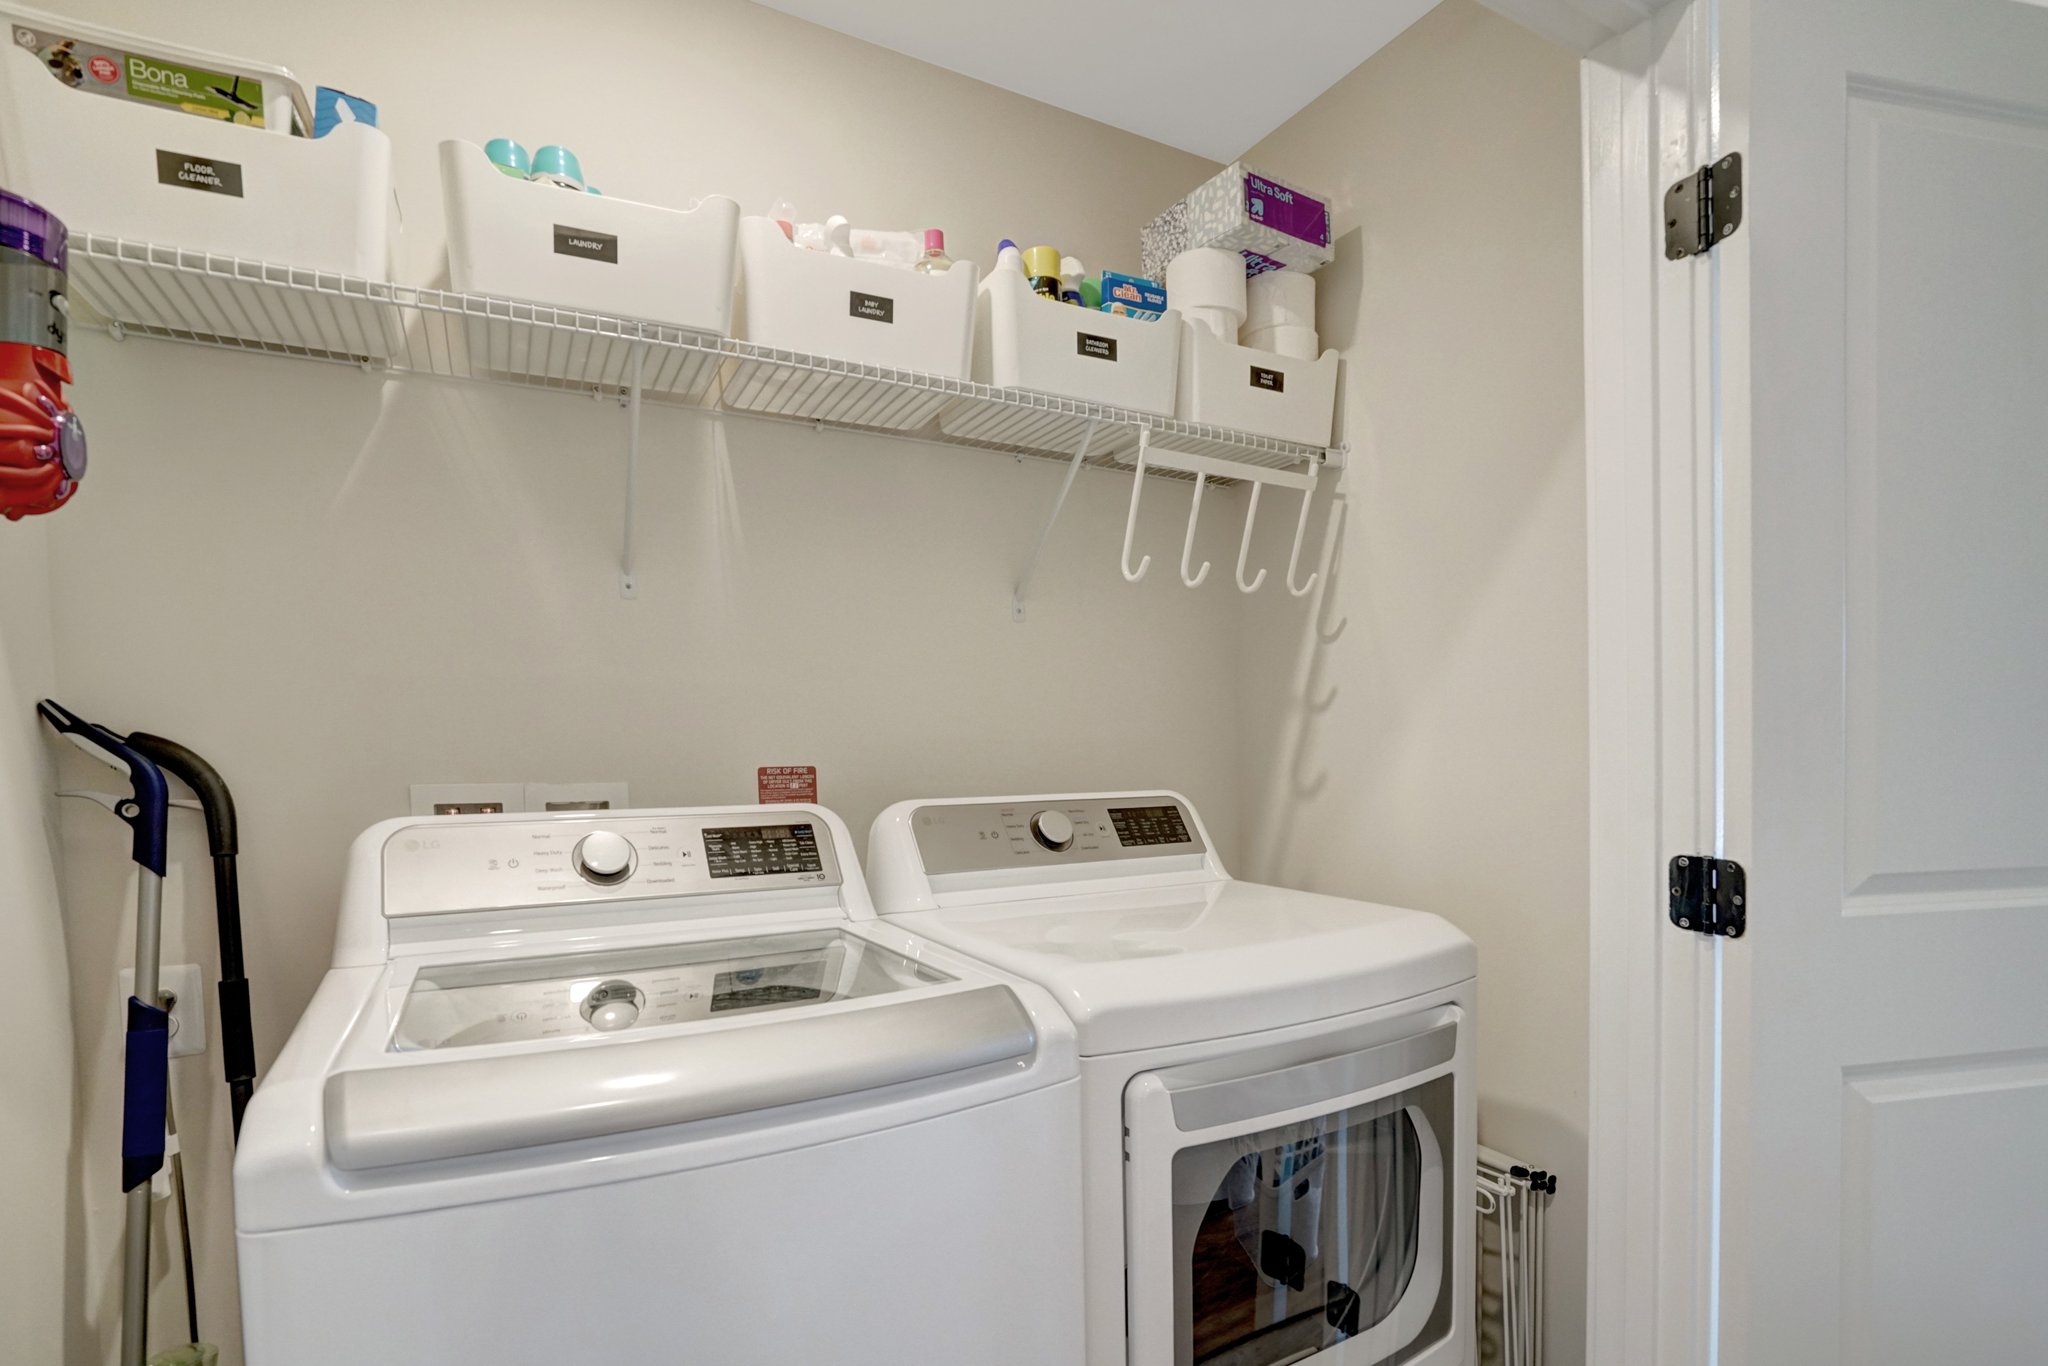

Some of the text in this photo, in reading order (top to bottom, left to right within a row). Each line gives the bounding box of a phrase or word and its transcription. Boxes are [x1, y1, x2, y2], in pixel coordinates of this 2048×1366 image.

[129, 58, 189, 89] Bona
[184, 162, 216, 176] FLOOR
[178, 171, 223, 187] CLEANER
[1250, 176, 1294, 205] Ultra Soft
[568, 238, 604, 251] LAUNDRY
[1112, 286, 1142, 303] Clean
[858, 306, 886, 317] LAUNDRY
[782, 767, 792, 775] OF
